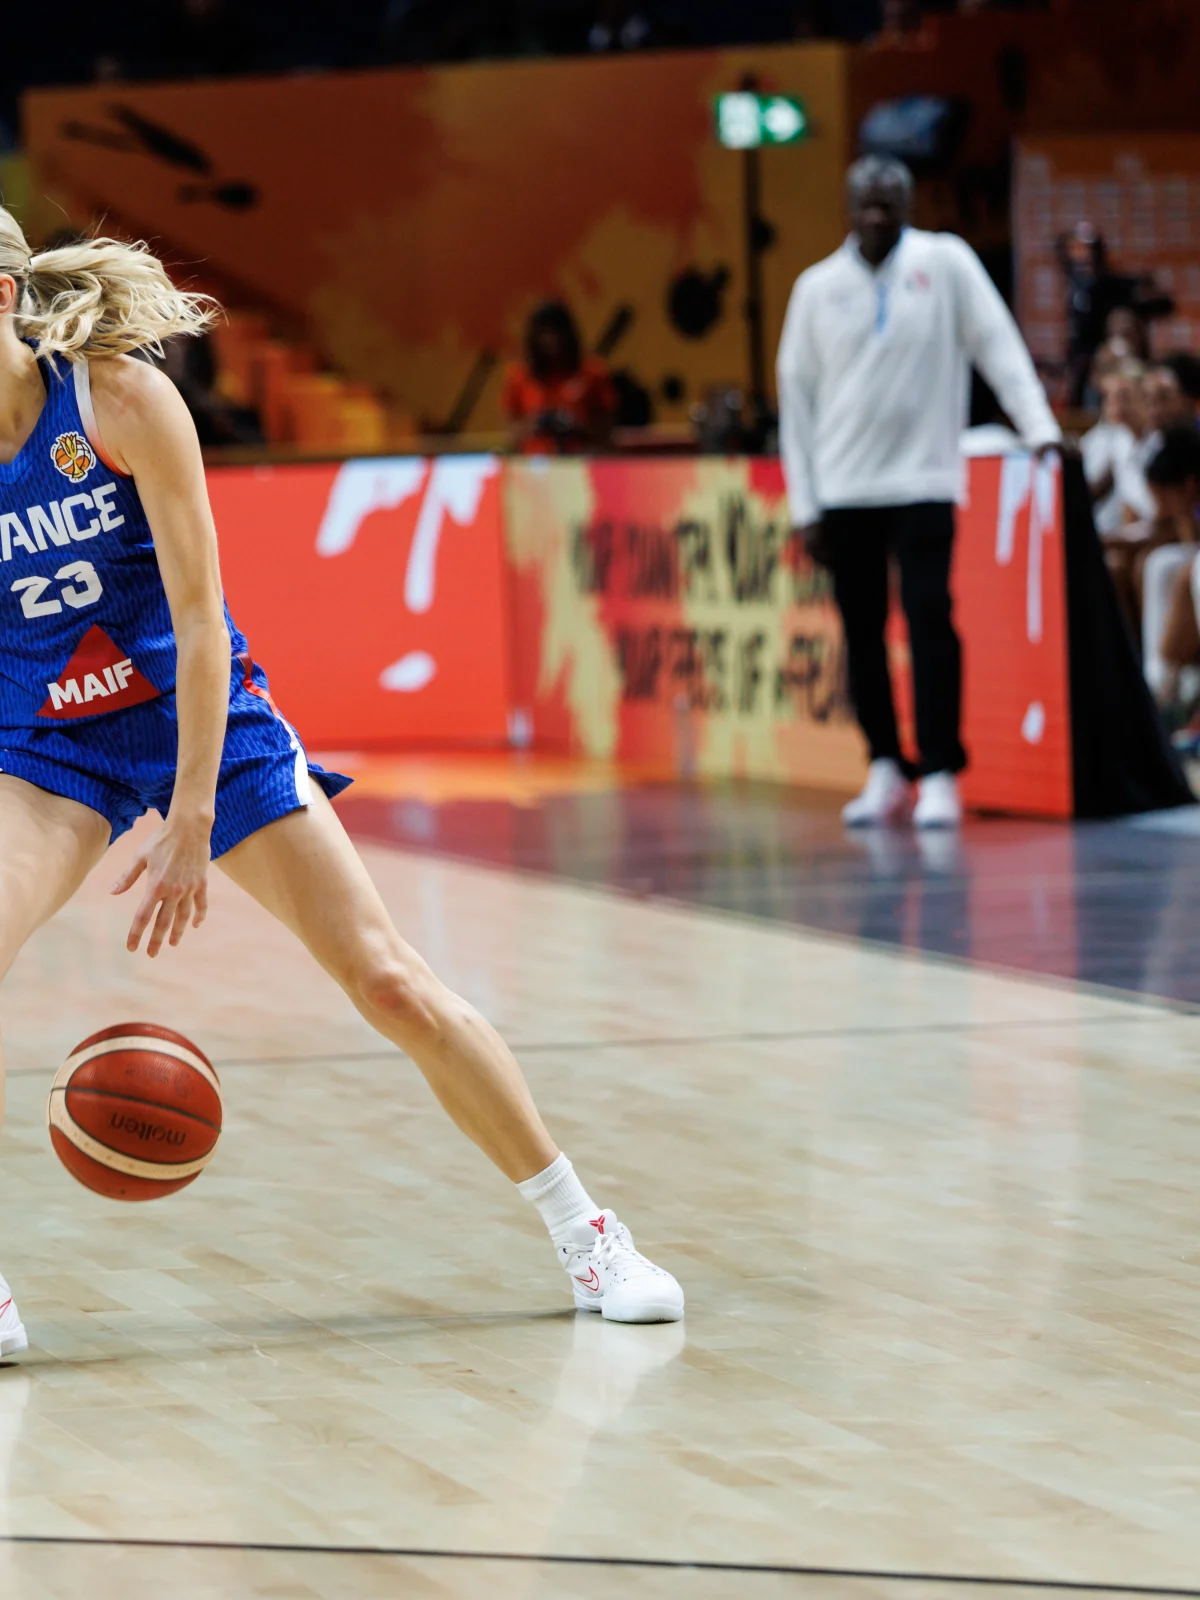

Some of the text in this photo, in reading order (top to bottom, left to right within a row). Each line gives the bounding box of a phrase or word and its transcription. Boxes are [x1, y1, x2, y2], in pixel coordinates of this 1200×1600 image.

[10, 560, 103, 619] 23
[47, 658, 134, 711] MAIF
[109, 1111, 187, 1147] molten
